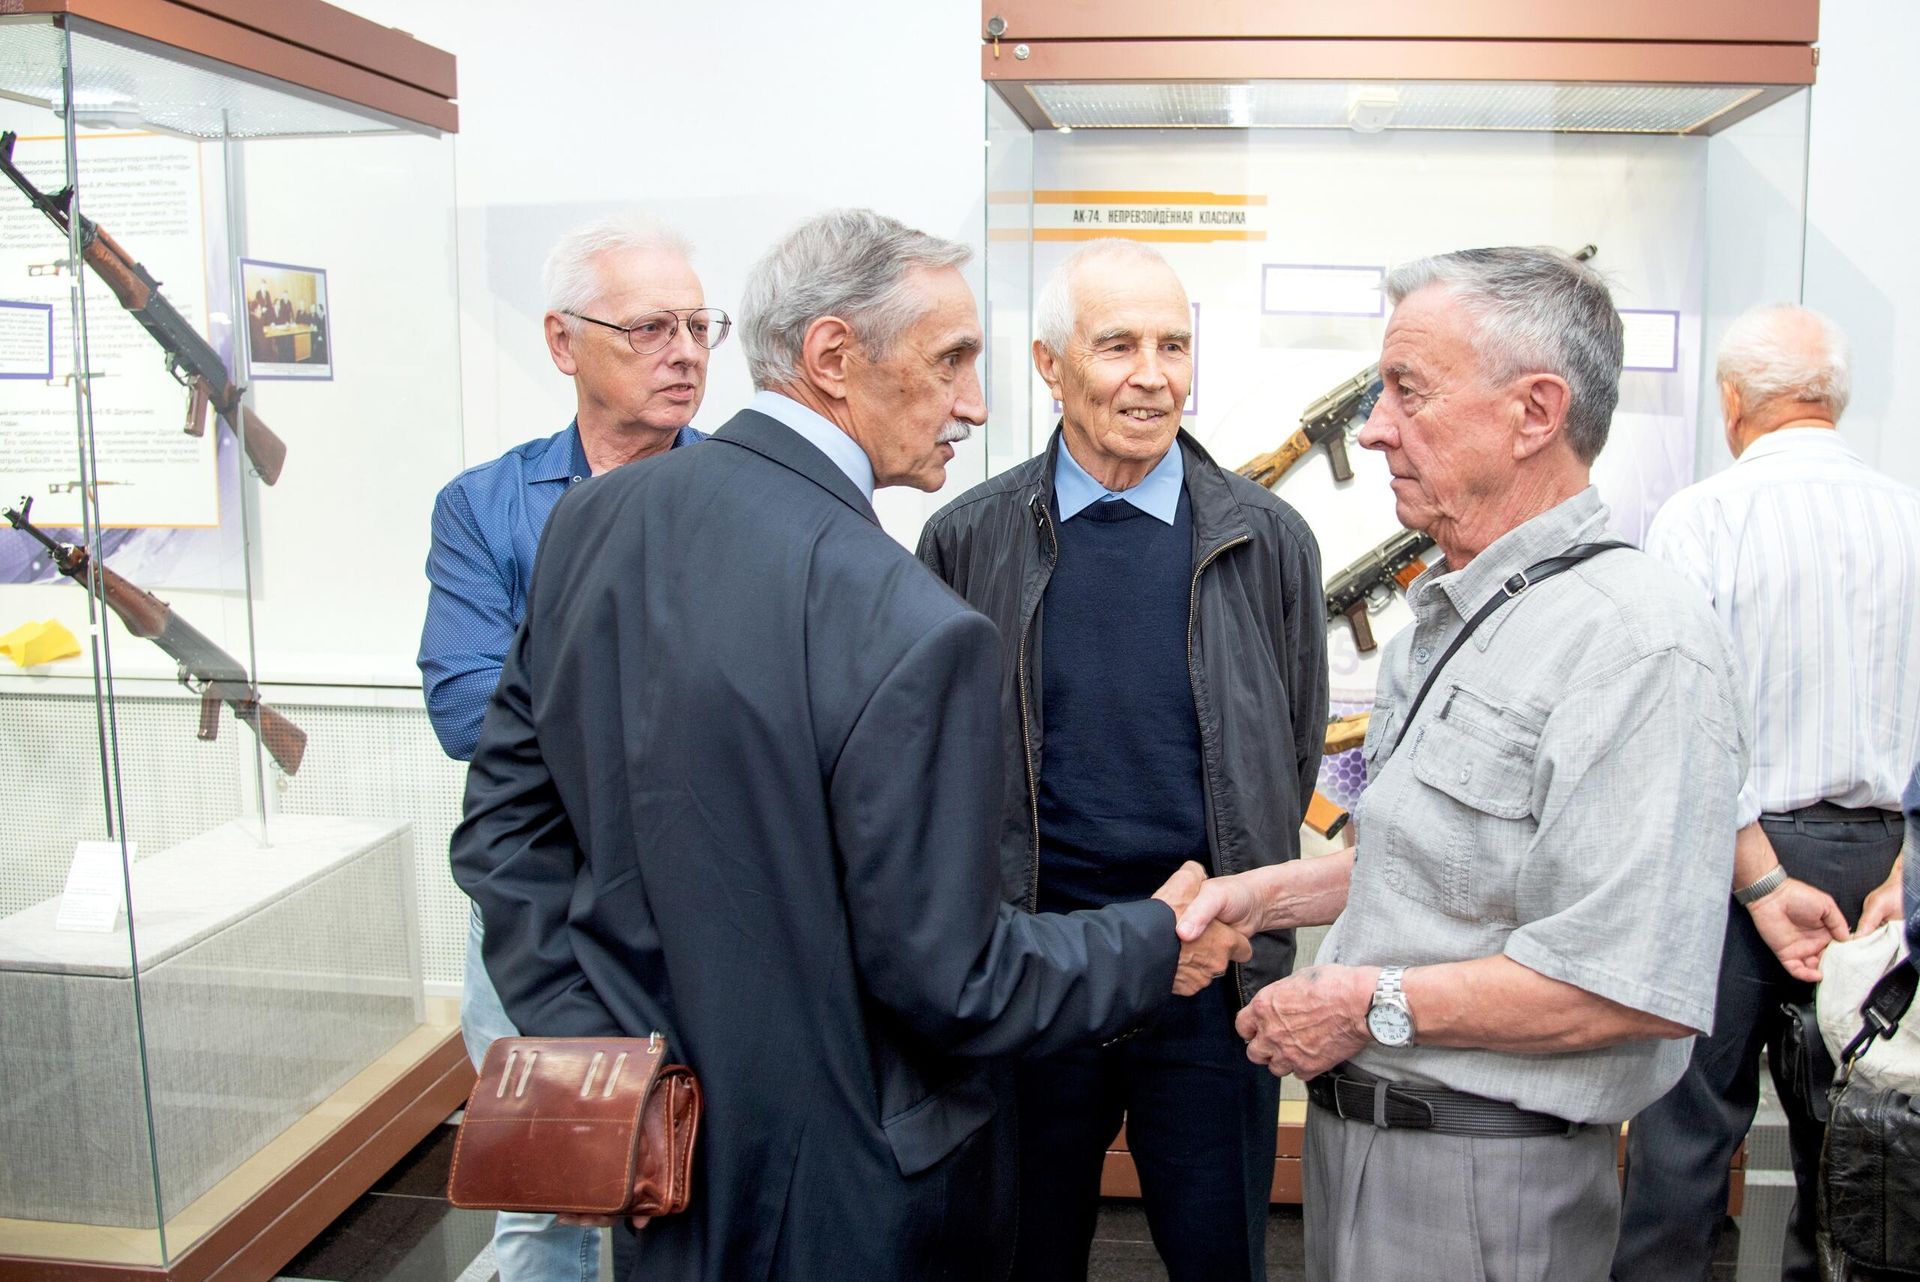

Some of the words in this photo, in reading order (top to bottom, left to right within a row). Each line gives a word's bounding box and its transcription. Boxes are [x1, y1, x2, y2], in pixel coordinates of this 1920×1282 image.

[1073, 209, 1102, 223] АК-74.
[1108, 207, 1193, 225] НЕПРЕВЗОЙДЁННАЯ
[1199, 210, 1246, 225] КЛАССИКА
